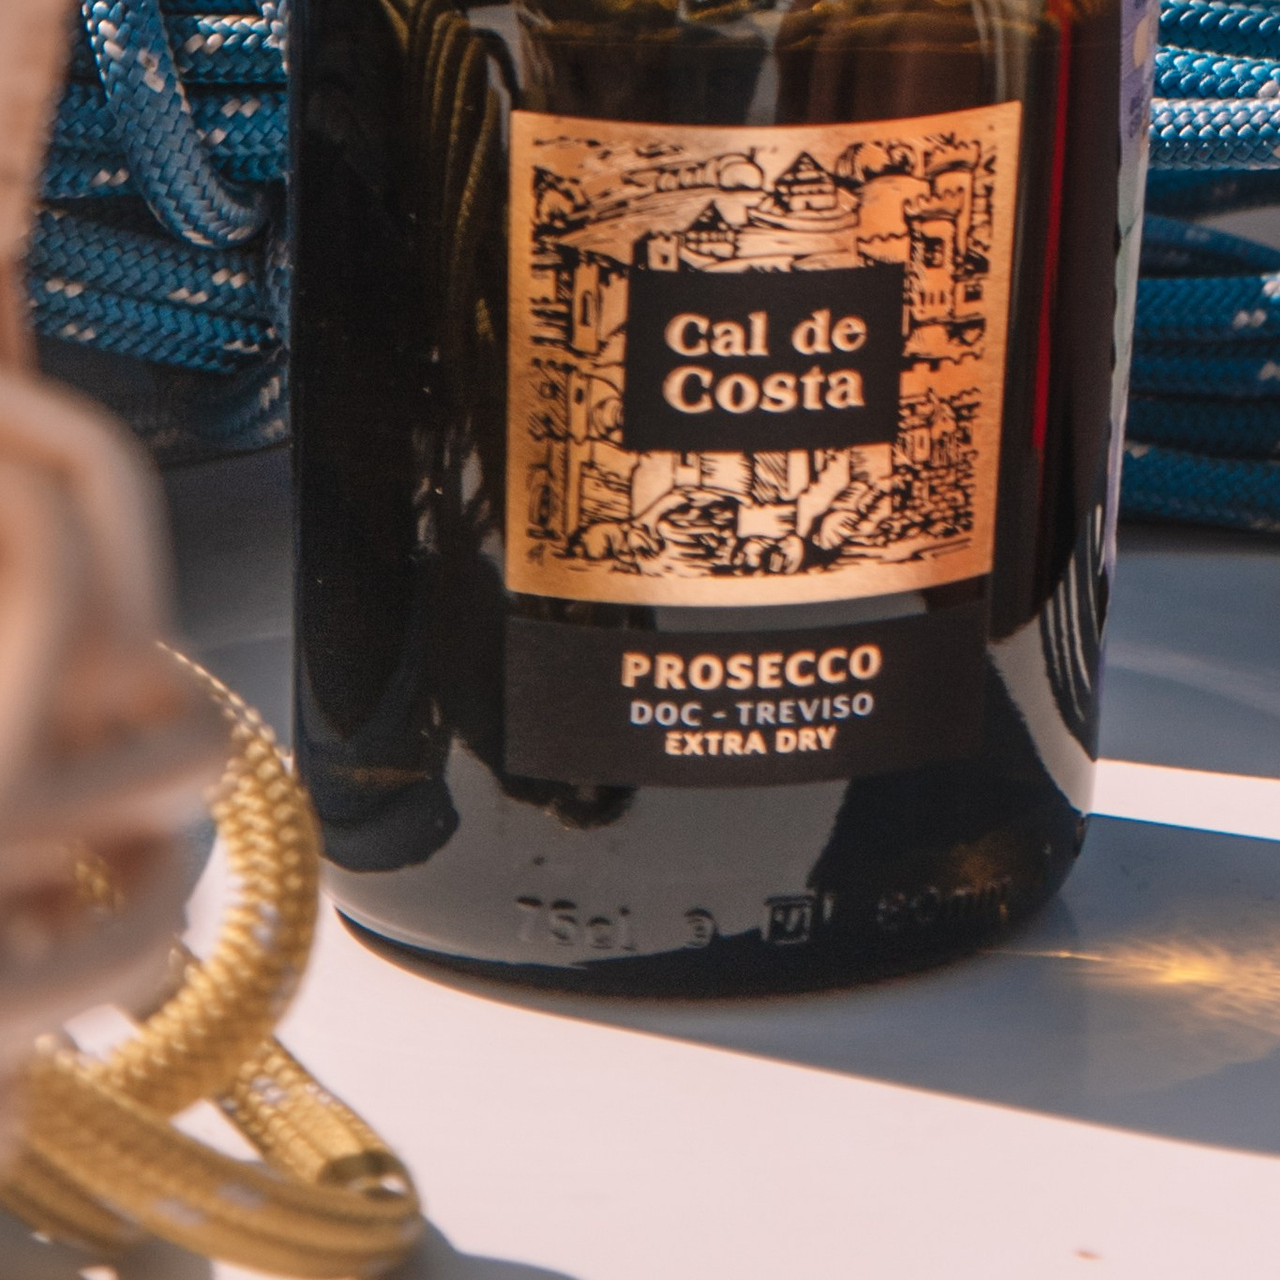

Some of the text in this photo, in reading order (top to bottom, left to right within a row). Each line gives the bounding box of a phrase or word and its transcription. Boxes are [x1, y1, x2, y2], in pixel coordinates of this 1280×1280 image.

[663, 308, 868, 357] Cal de
[662, 365, 865, 414] Costa
[620, 644, 882, 690] PROSECCO
[629, 700, 702, 726] DOC
[735, 692, 874, 725] TREVISO
[664, 725, 837, 756] EXTRA DRY
